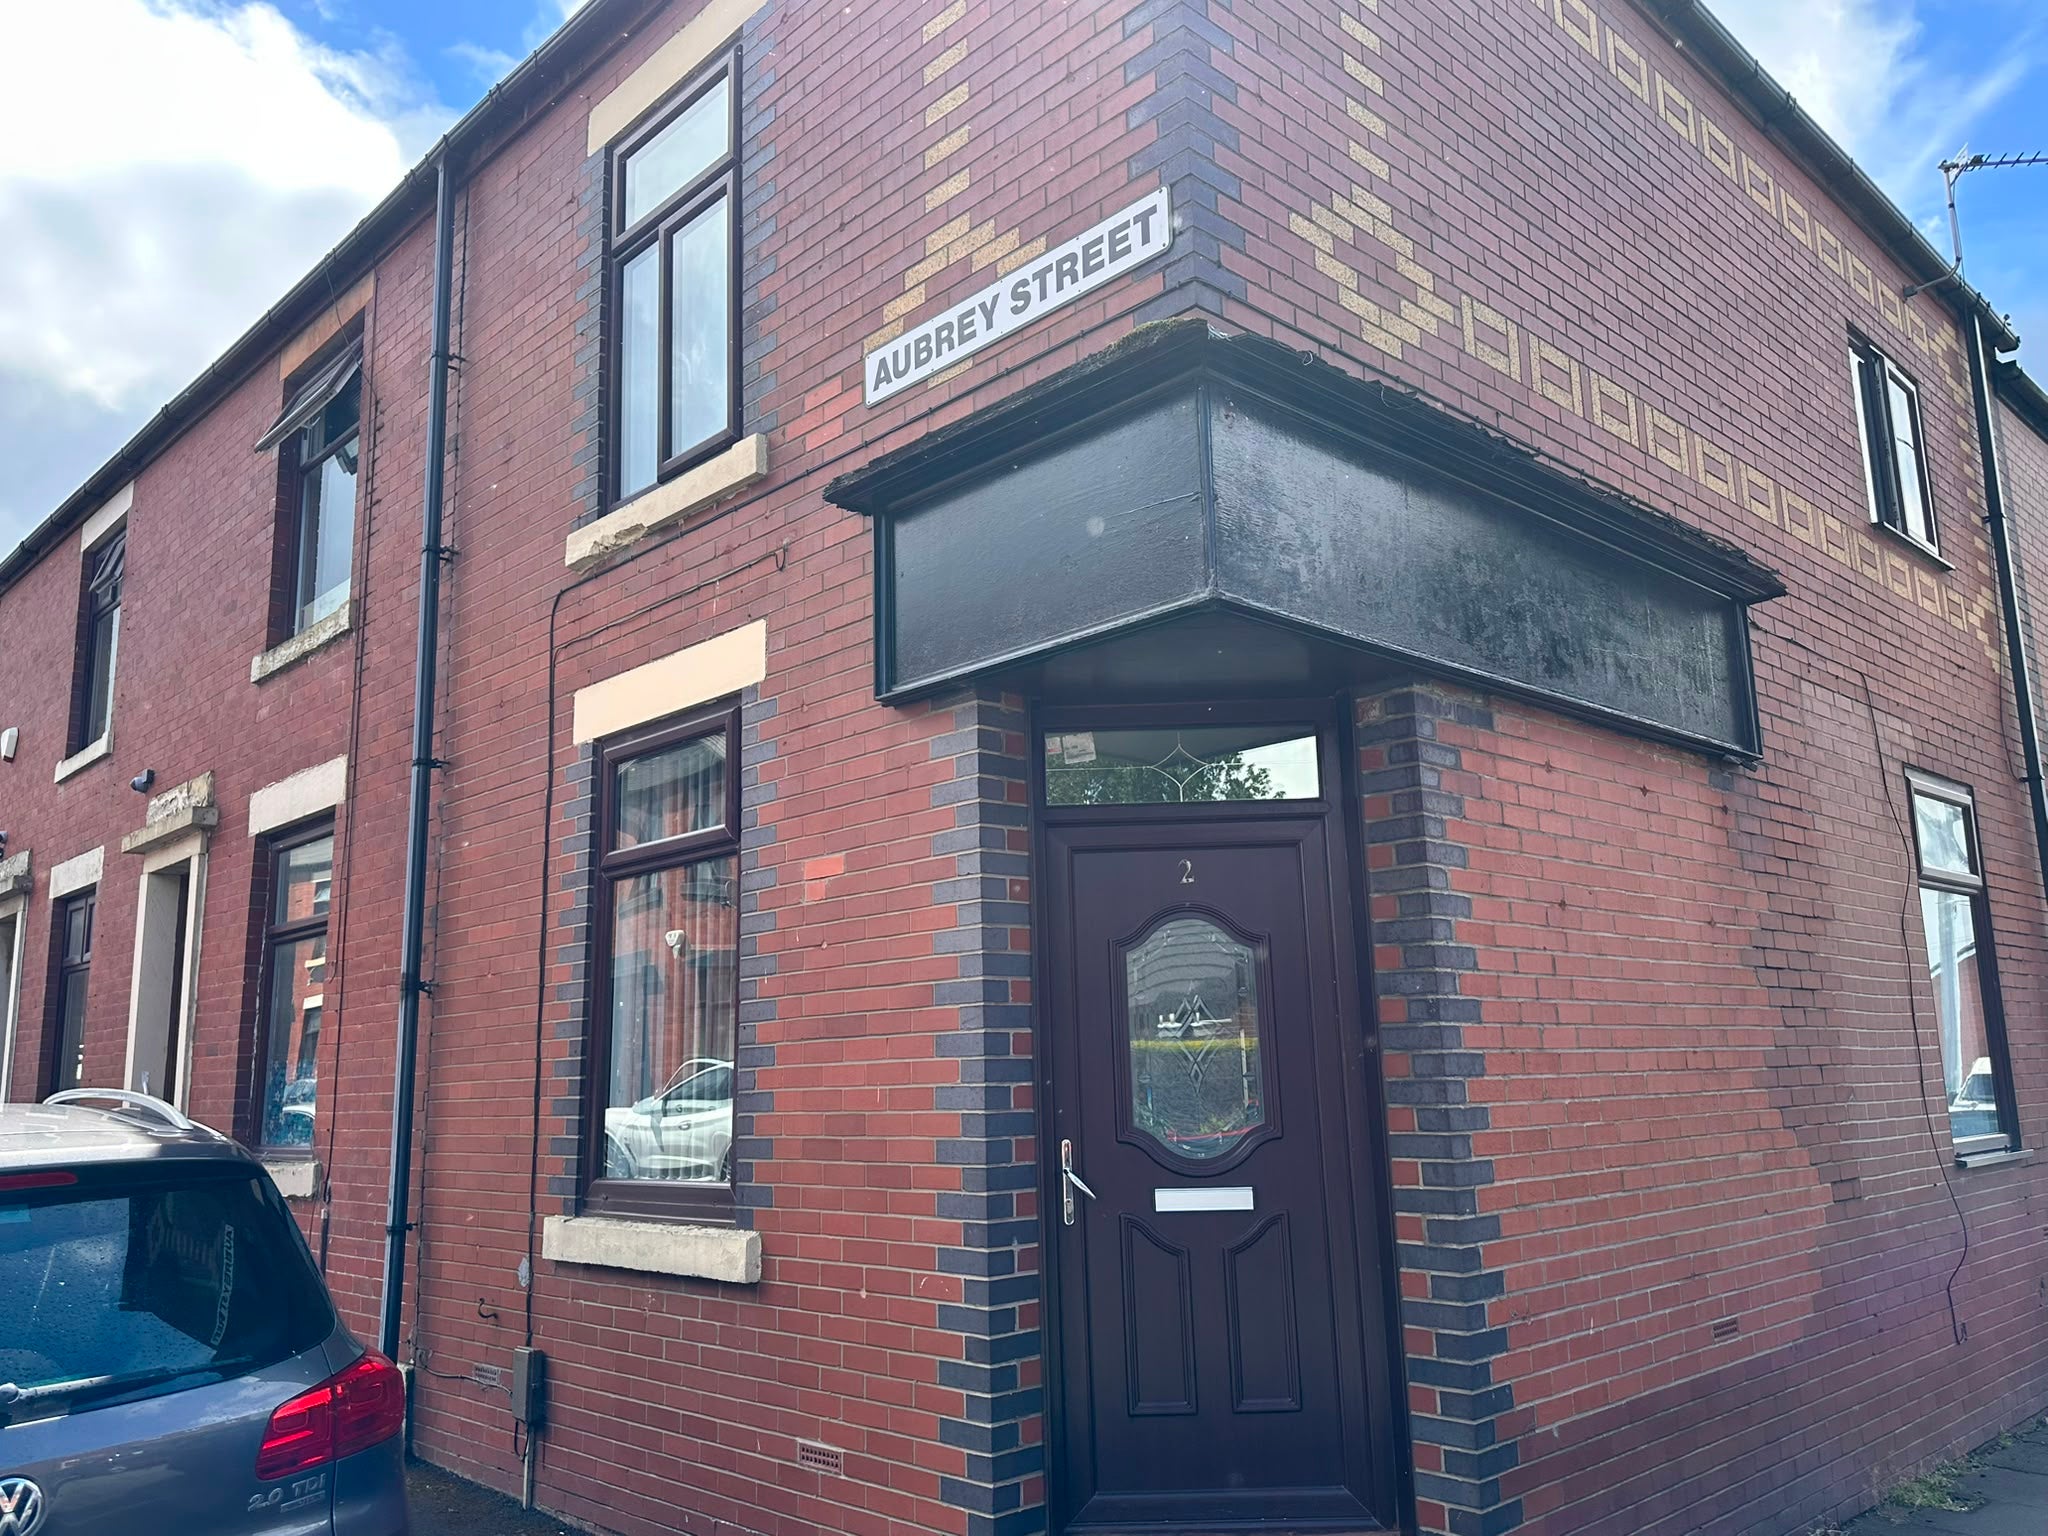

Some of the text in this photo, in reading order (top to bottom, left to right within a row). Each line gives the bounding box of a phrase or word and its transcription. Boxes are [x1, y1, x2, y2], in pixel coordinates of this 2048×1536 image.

[873, 204, 1157, 392] AUBREY STREET
[1178, 859, 1195, 884] 2
[292, 1473, 326, 1496] TDI
